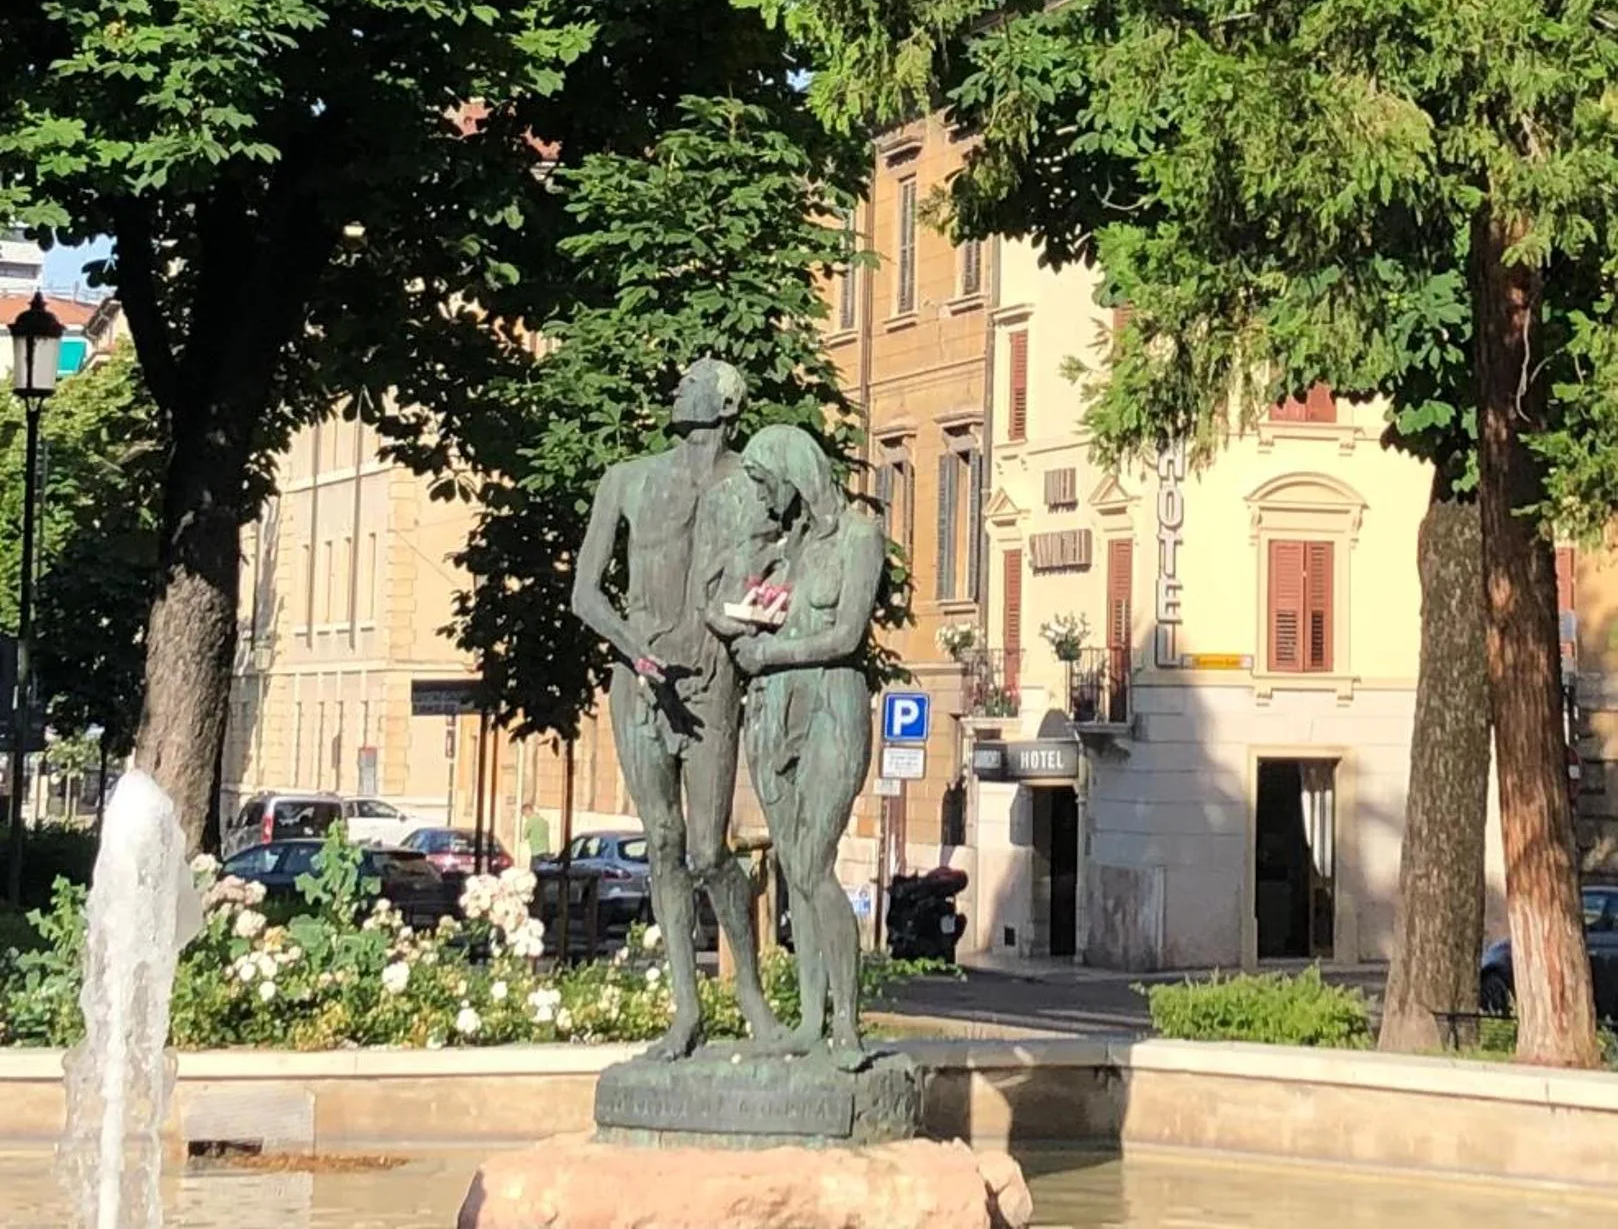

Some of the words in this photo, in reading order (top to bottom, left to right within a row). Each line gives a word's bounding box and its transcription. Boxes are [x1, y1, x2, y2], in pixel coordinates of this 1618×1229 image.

[1155, 435, 1184, 668] HOTEL
[893, 699, 919, 735] P
[1020, 749, 1064, 770] HOTEL
